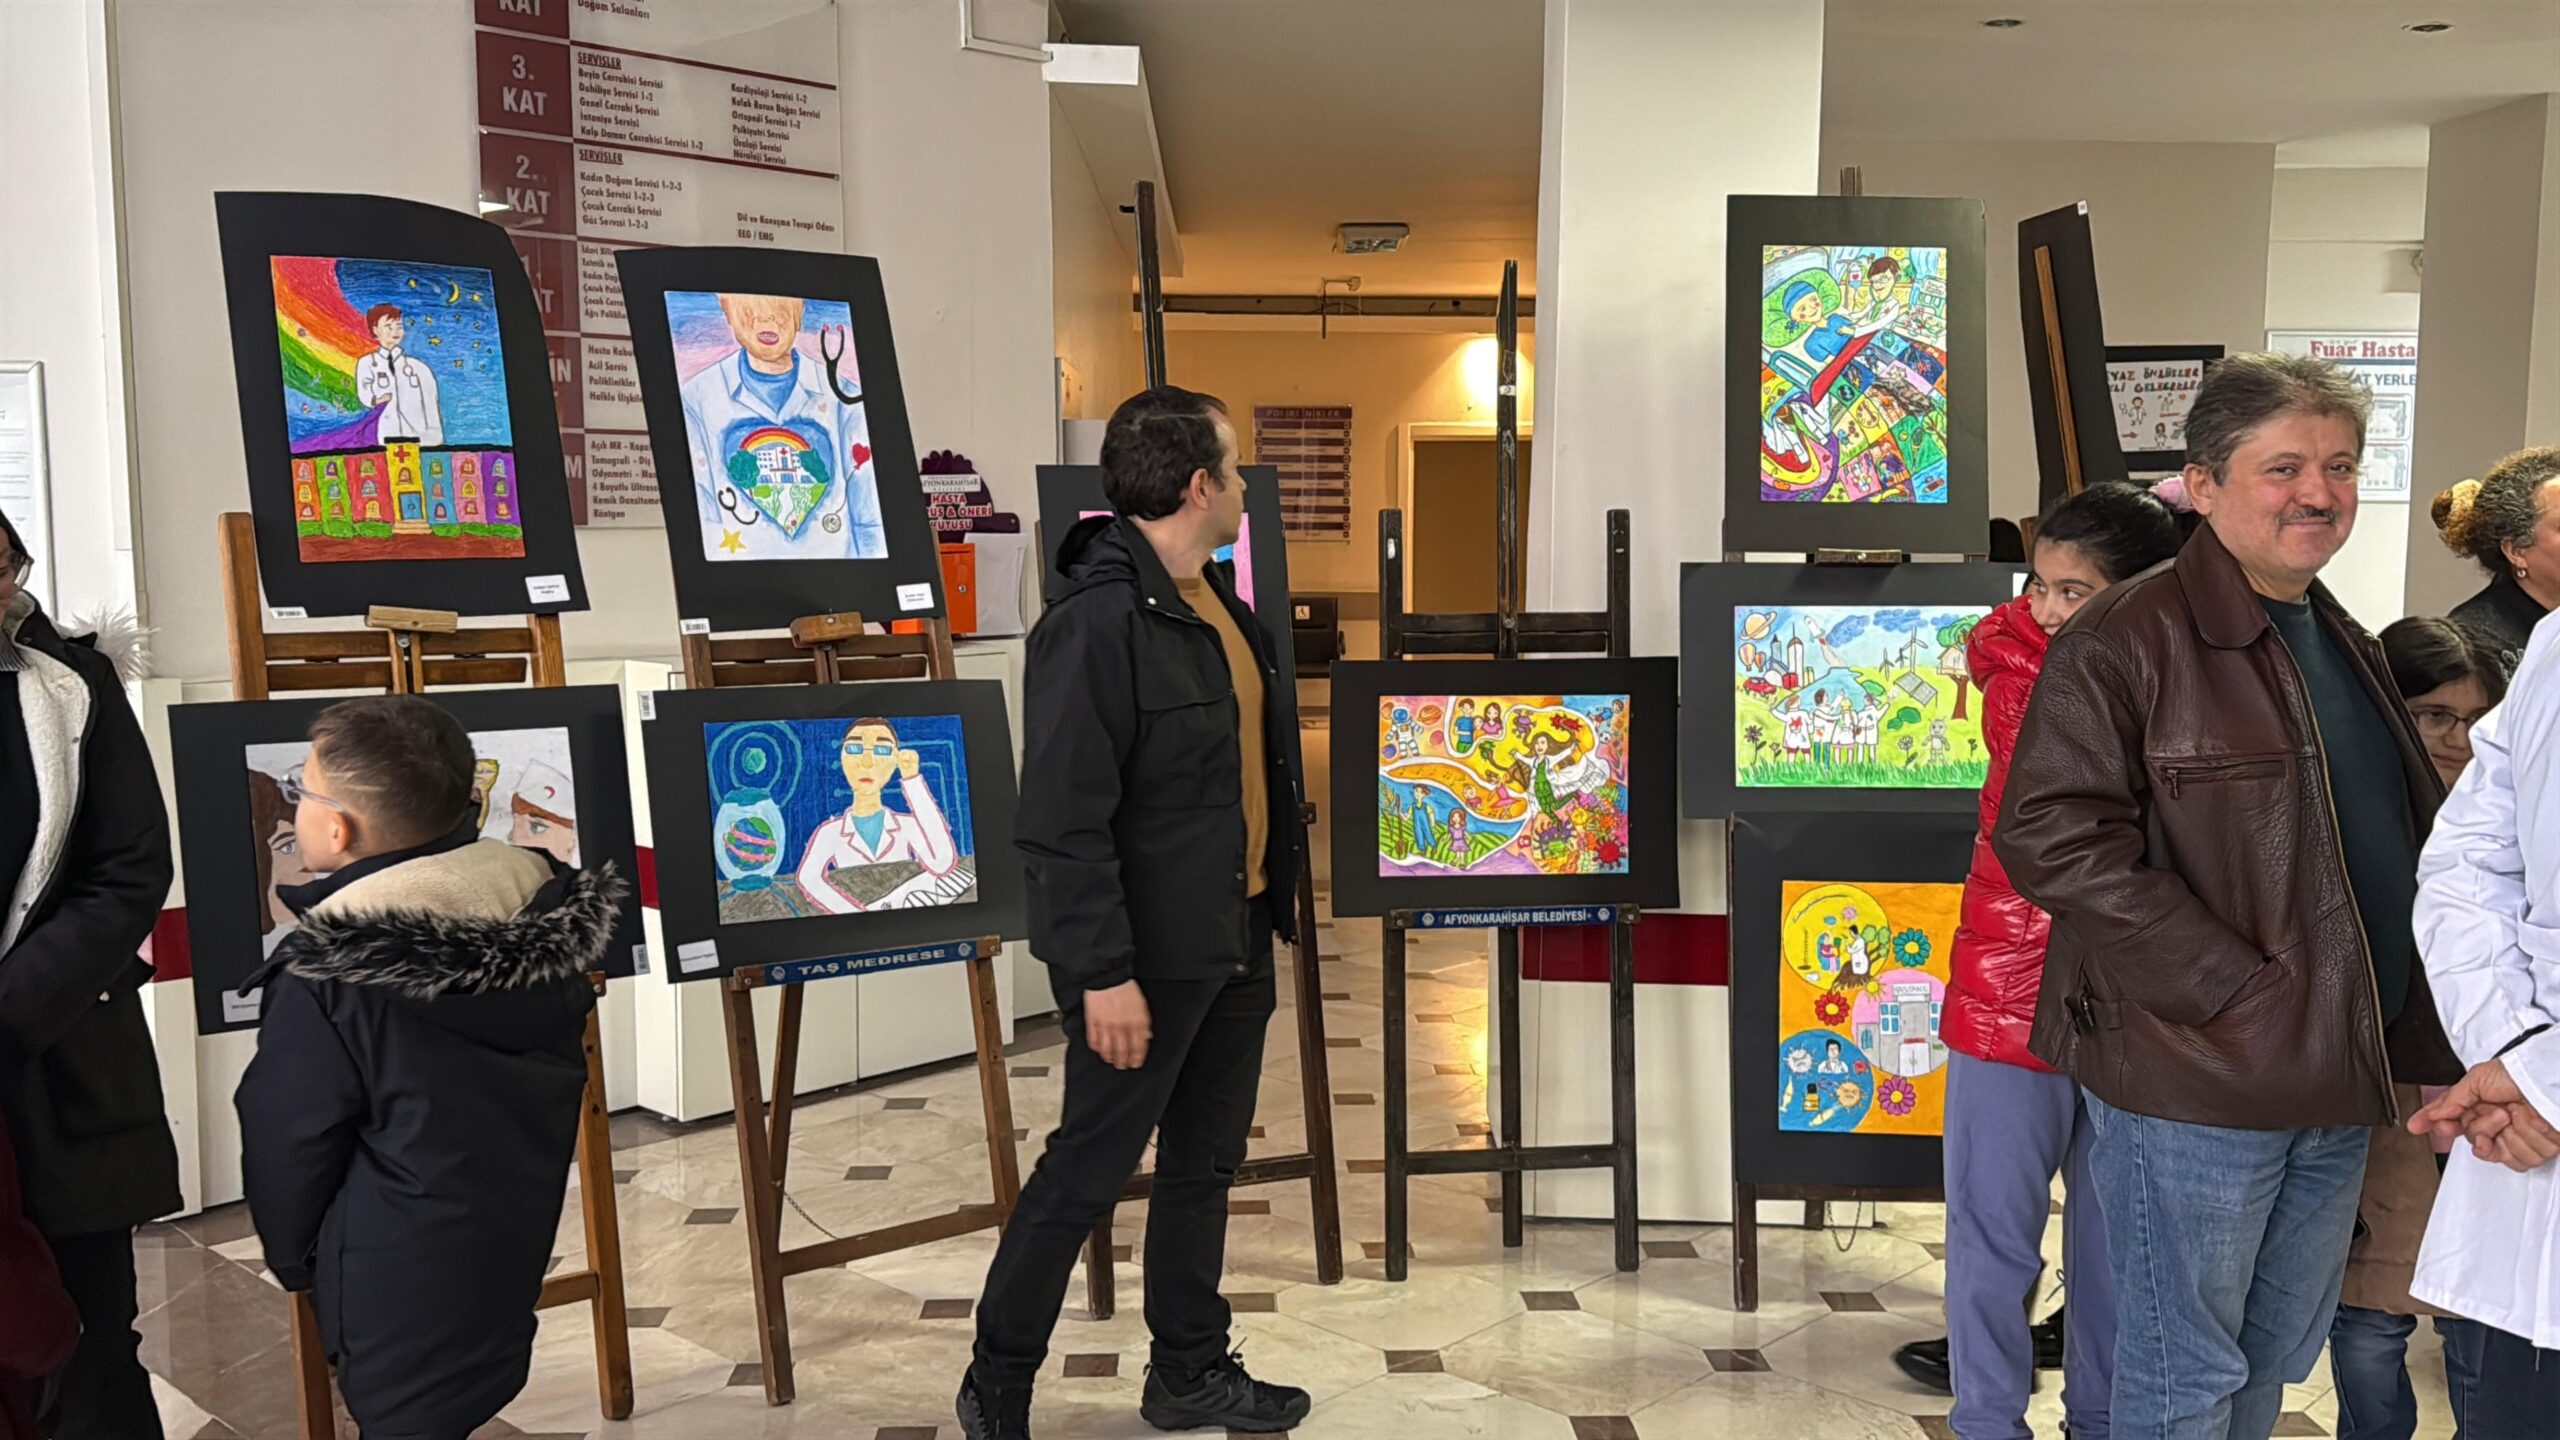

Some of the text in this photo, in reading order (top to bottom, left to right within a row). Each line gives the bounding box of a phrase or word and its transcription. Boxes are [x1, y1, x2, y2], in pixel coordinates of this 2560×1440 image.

[512, 54, 535, 80] 3.
[578, 68, 663, 88] Beyin Cerrahisi Servisi
[579, 83, 611, 96] Dahiliye
[613, 87, 638, 99] Servisi
[731, 83, 769, 98] Kardiyoloji
[771, 90, 793, 101] Servisi
[503, 86, 548, 116] KAT
[580, 97, 660, 116] Genel Cerrahi Servisi
[732, 97, 751, 107] Kulak
[799, 107, 821, 119] Servisi
[614, 116, 639, 128] Servisi
[732, 111, 763, 123] Ortopedi
[765, 115, 787, 127] Servisi
[581, 126, 598, 138] Kalp
[601, 129, 626, 140] Damar
[629, 132, 662, 145] Cerrahisi
[664, 136, 688, 148] Servisi
[732, 124, 789, 140] Psikiyatri Servisi
[760, 141, 782, 153] Servisi
[764, 154, 786, 165] Servisi
[516, 155, 538, 180] 2.
[580, 172, 603, 183] Kadın
[605, 174, 632, 187] Doğum
[634, 177, 659, 189] Servisi
[506, 186, 550, 215] KAT
[581, 186, 654, 202] Çocuk Servisi 1-2-3
[582, 200, 662, 217] Çocuk Cerrahi Servisi
[600, 217, 625, 227] Servisi
[737, 212, 748, 222] Dil
[760, 216, 790, 228] Konuşma
[792, 219, 813, 231] Terapi
[816, 222, 835, 232] Odası
[738, 229, 751, 239] EEG
[759, 231, 774, 241] EMG
[588, 345, 633, 356] Hasta Kabu
[2310, 340, 2416, 358] Fuar Hasta
[589, 361, 628, 372] Acil Servis
[589, 376, 637, 387] Poliklinikler
[2353, 374, 2417, 385] AT YERLE
[590, 391, 615, 402] Halkla
[591, 441, 607, 452] Açık
[610, 441, 622, 450] MR
[630, 441, 649, 452] Kapa
[592, 455, 630, 467] Tomografi
[600, 482, 628, 493] Boyutlu
[631, 483, 658, 492] Ultraso
[593, 496, 659, 505] Kemik Dansitome
[931, 493, 967, 505] HASTA
[594, 509, 625, 520] Röntgen
[958, 502, 993, 517] ÖNERİ
[1532, 908, 1587, 923] BELEDİYESİ
[797, 948, 946, 975] TAŞ MEDRESE
